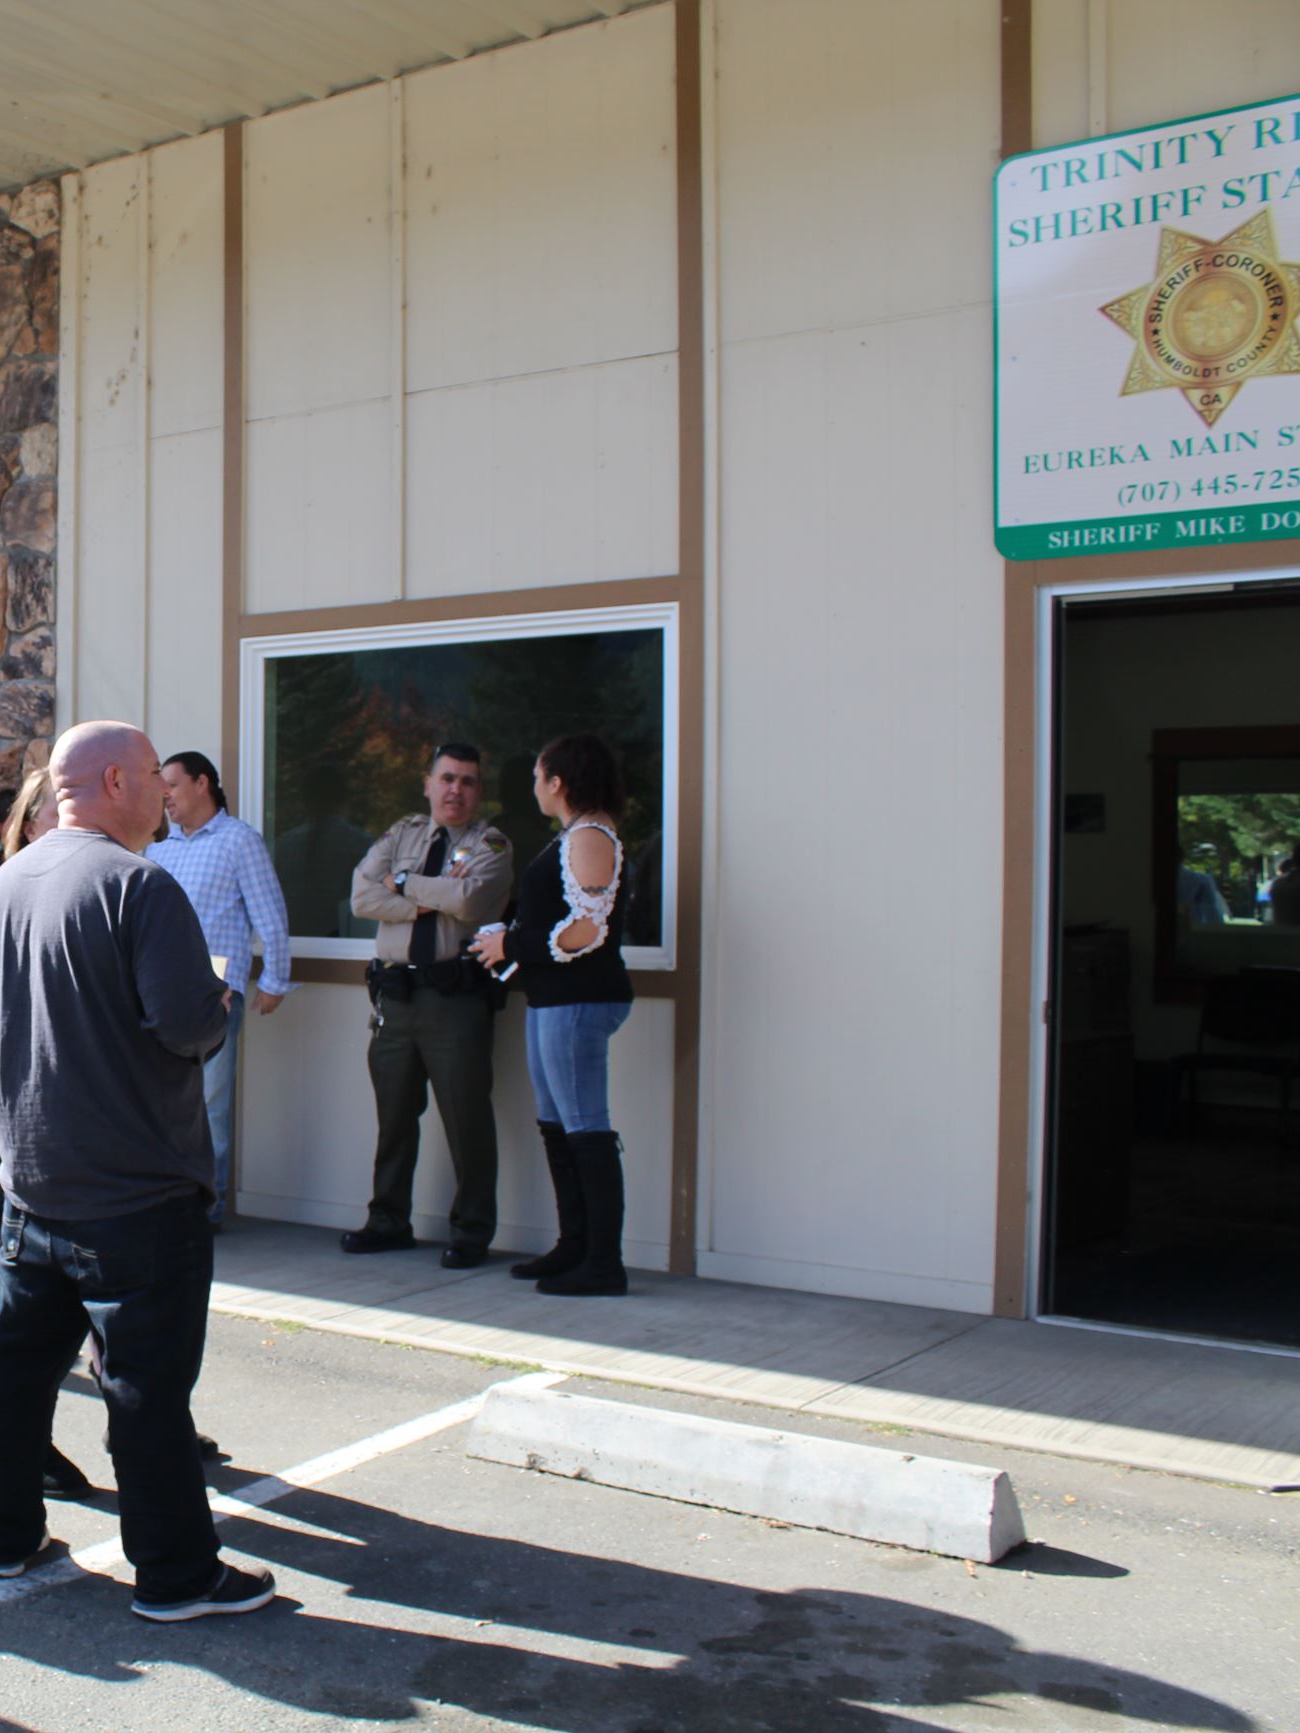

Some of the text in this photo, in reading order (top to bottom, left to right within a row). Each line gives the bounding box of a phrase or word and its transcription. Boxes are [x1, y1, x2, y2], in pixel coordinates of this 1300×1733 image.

[1031, 124, 1236, 193] TRINITY
[1008, 185, 1206, 248] SHERIFF
[1153, 324, 1279, 379] HUMBOLDT COUNTY
[1200, 393, 1223, 407] CA
[1023, 443, 1151, 475] EUREKA
[1169, 429, 1260, 461] MAIN
[1117, 479, 1182, 508] (707)
[1047, 522, 1161, 550] SHERIFF
[1175, 513, 1246, 539] MIKE
